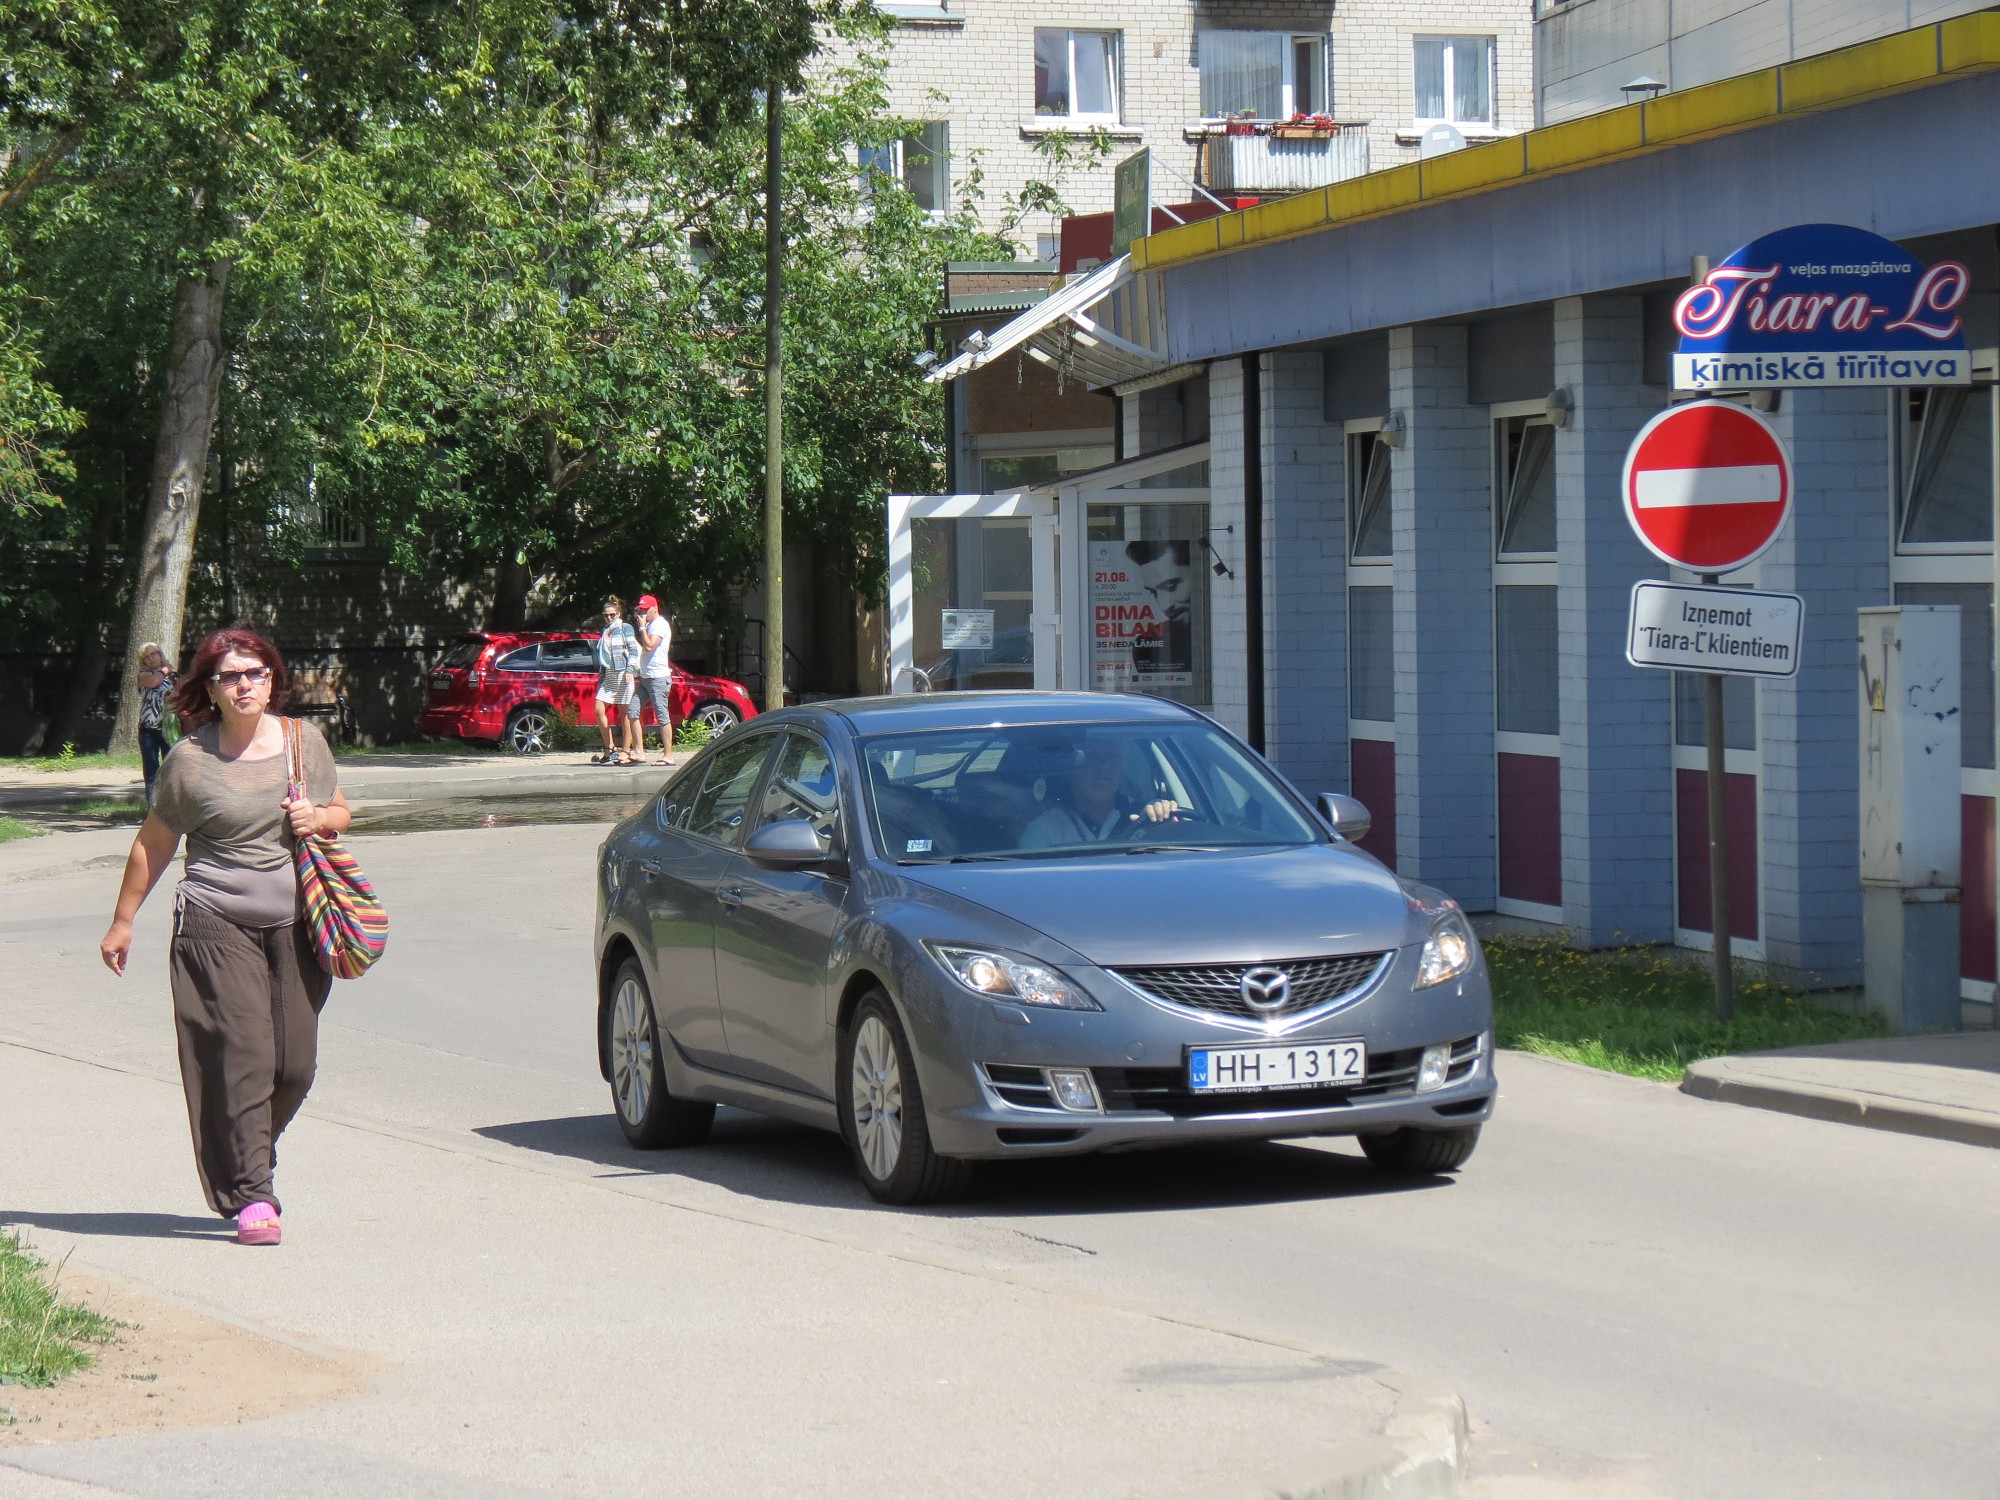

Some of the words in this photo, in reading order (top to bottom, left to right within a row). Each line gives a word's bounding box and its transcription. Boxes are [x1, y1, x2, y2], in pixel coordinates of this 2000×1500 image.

[1790, 263, 1827, 278] veļas
[1830, 262, 1911, 277] mazgātava
[1673, 261, 1971, 338] Tiara-L
[1837, 355, 1957, 380] tīrītava
[1095, 571, 1129, 583] 21.08.
[1095, 604, 1155, 620] DIMA
[1682, 601, 1752, 627] Izņemot
[1096, 622, 1165, 638] BILAN
[1709, 632, 1789, 660] klientiem
[1216, 1047, 1359, 1083] HH-1312
[1193, 1073, 1206, 1082] LV
